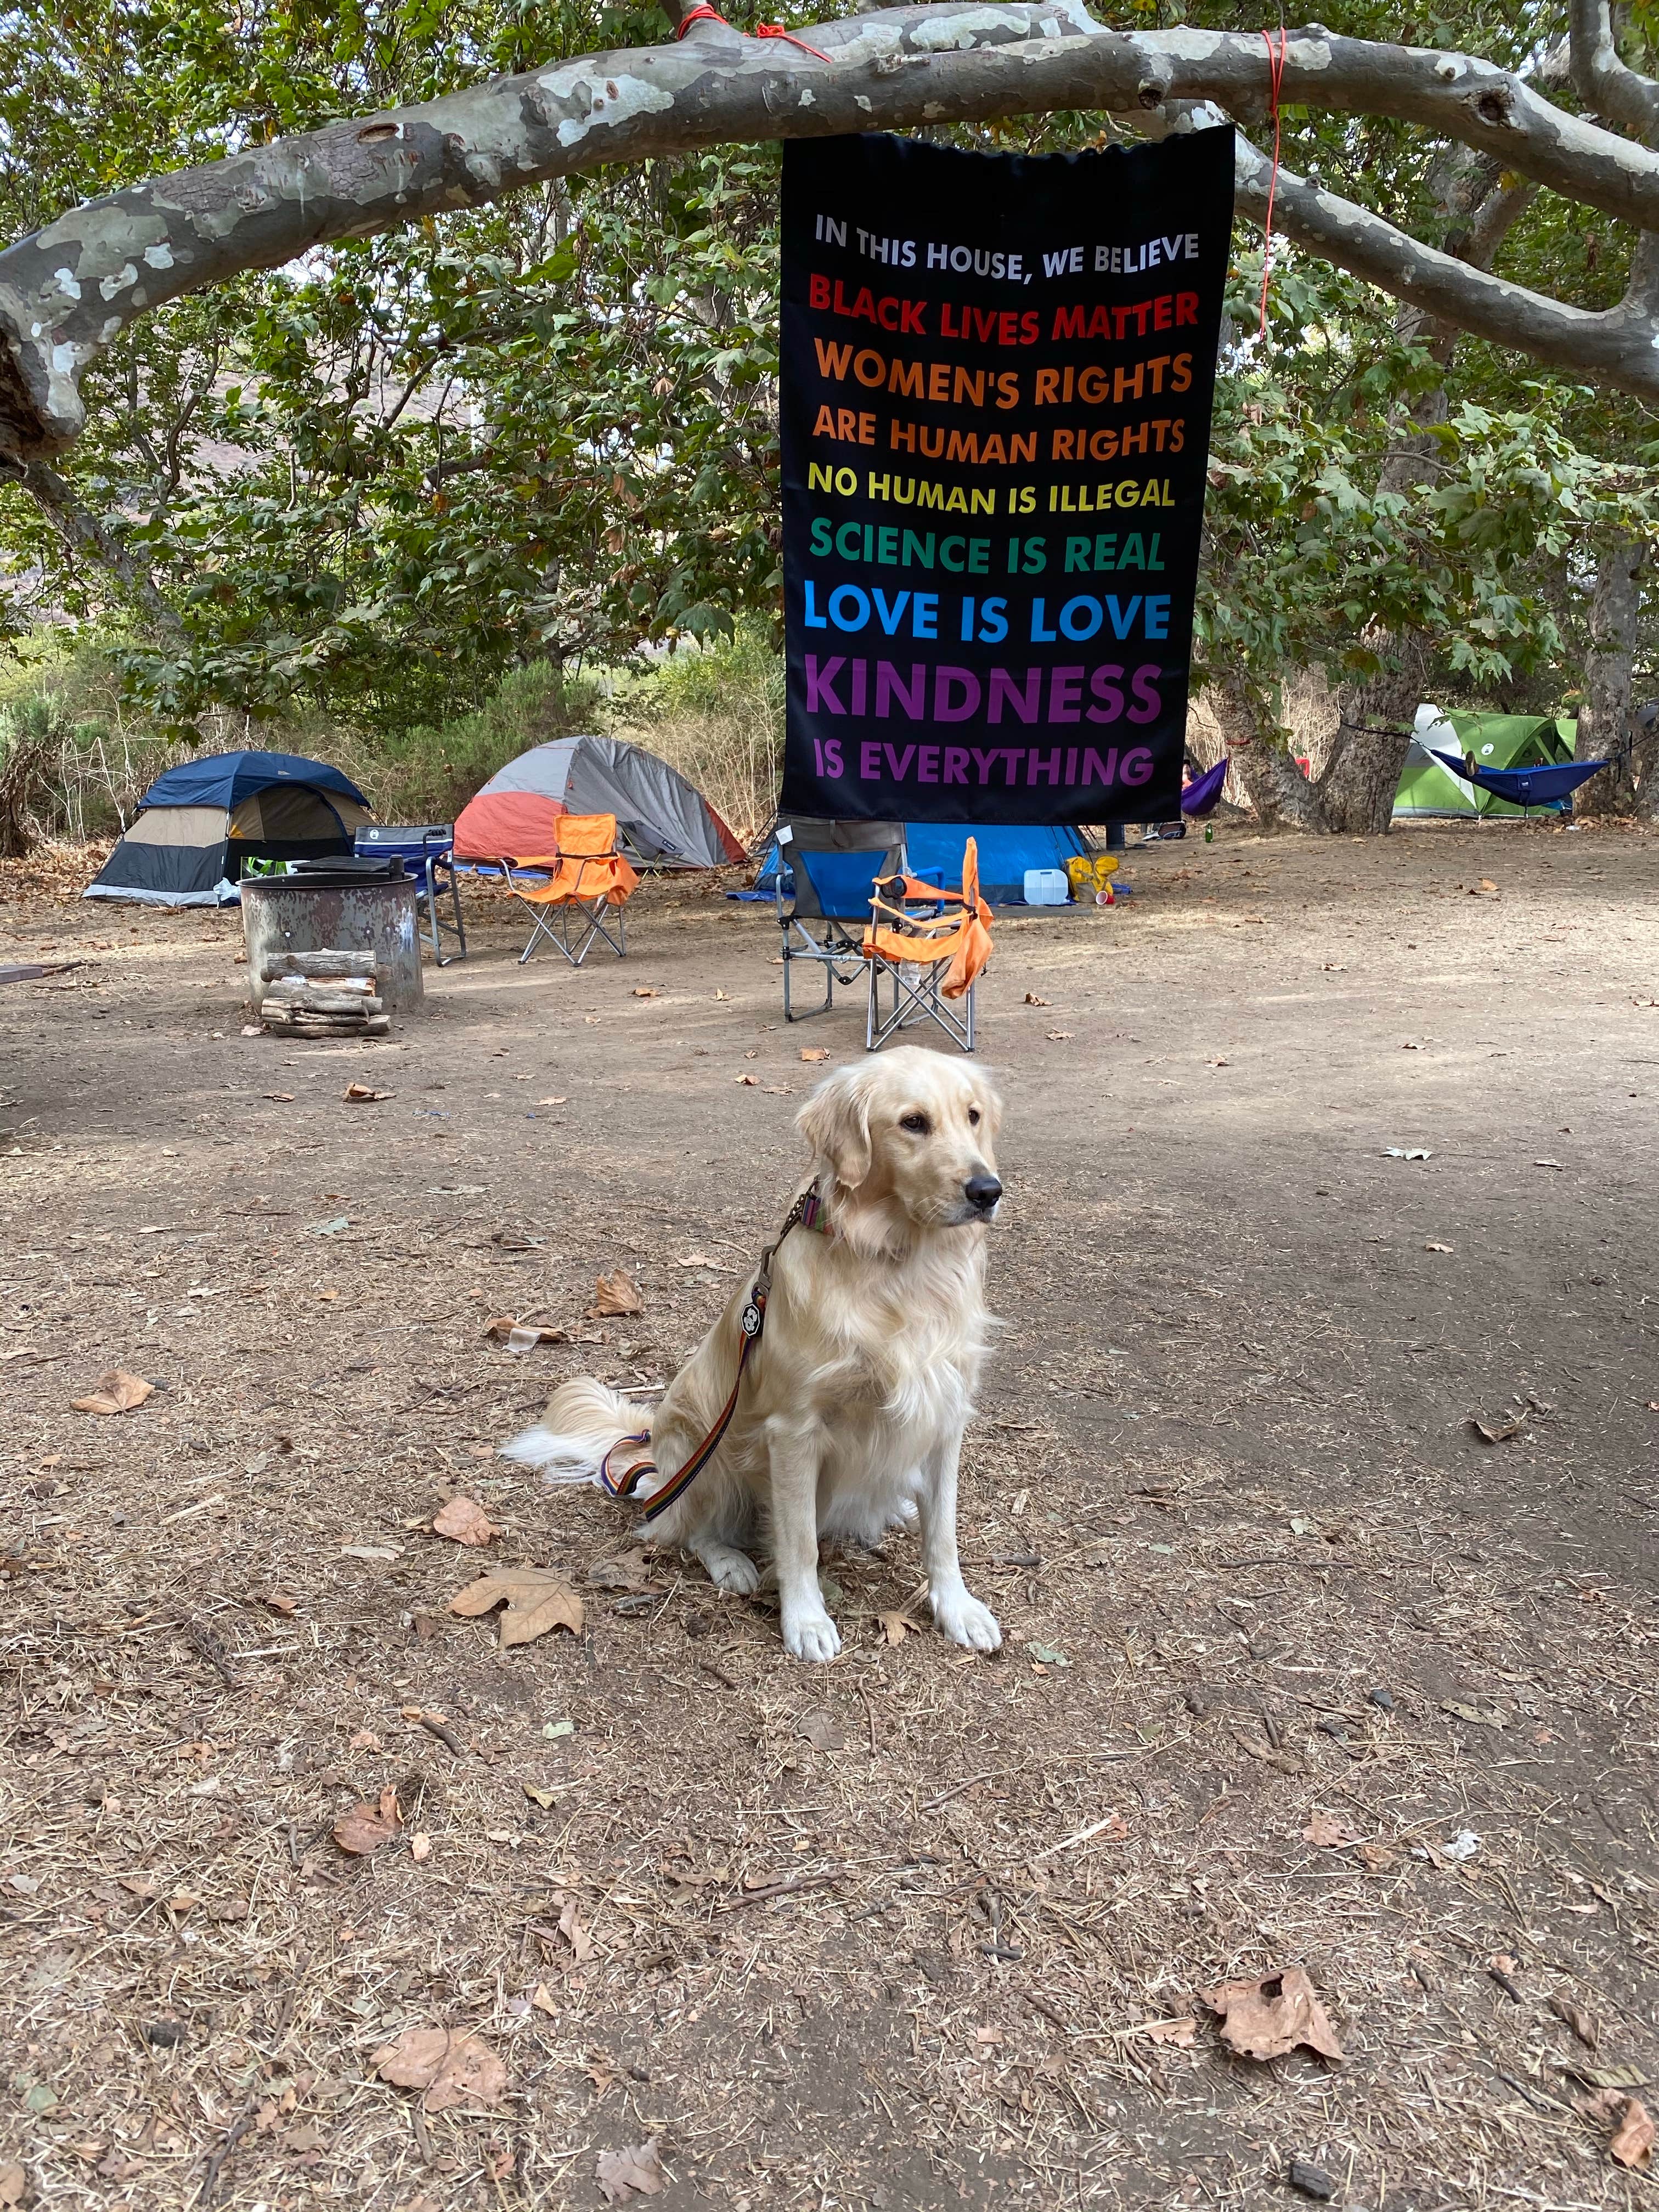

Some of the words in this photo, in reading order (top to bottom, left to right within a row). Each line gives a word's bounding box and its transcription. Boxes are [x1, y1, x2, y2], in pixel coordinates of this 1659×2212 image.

[816, 214, 847, 247] IN
[856, 228, 916, 267] THIS
[927, 244, 1033, 284] HOUSE,
[1044, 247, 1084, 277] WE
[1096, 234, 1199, 273] BELIEVE
[809, 274, 927, 334] BLACK
[941, 303, 1039, 345] LIVES
[1052, 292, 1199, 340] MATTER
[815, 338, 1019, 409] WOMEN'S
[1035, 353, 1192, 405] RIGHTS
[812, 405, 876, 445] ARE
[890, 419, 1036, 464] HUMAN
[1052, 419, 1184, 460] RIGHTS
[808, 462, 857, 496] NO
[868, 472, 995, 514] HUMAN
[1009, 487, 1036, 514] IS
[1049, 479, 1175, 512] ILLEGAL
[809, 518, 990, 573] SCIENCE
[1008, 537, 1046, 574] IS
[1065, 533, 1165, 572] REAL
[804, 580, 938, 639] LOVE
[962, 597, 1008, 643] IS
[1030, 595, 1171, 642] LOVE
[805, 654, 1162, 724] KINDNESS
[814, 739, 844, 778] IS
[860, 742, 1154, 786] EVERYTHING
